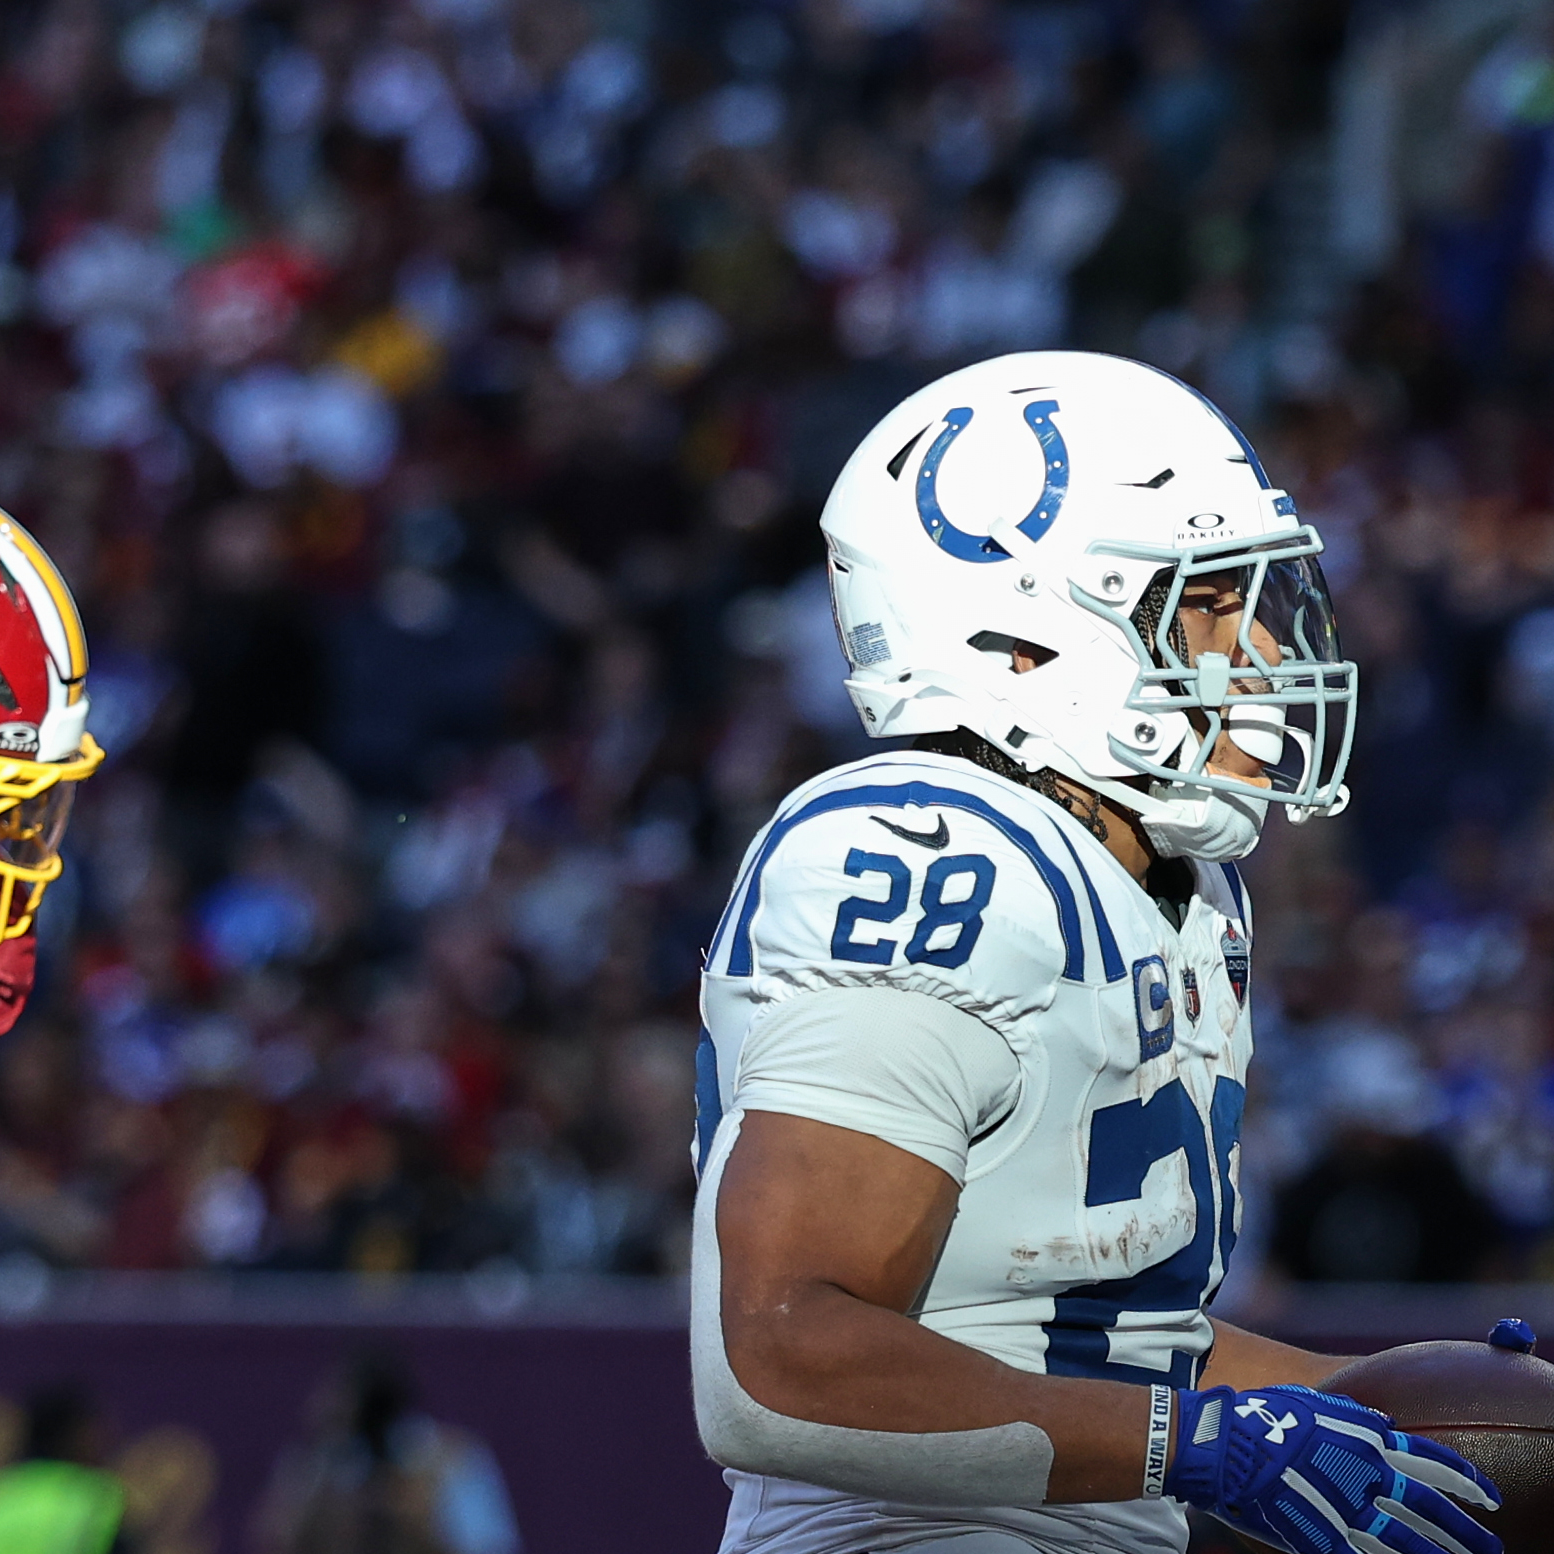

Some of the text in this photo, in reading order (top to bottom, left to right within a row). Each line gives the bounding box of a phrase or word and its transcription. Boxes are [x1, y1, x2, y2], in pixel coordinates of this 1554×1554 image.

[1177, 529, 1236, 540] OAKLEY
[831, 849, 996, 970] 28
[1139, 962, 1173, 1033] C
[1152, 1420, 1167, 1432] A
[1147, 1438, 1166, 1482] WAY
